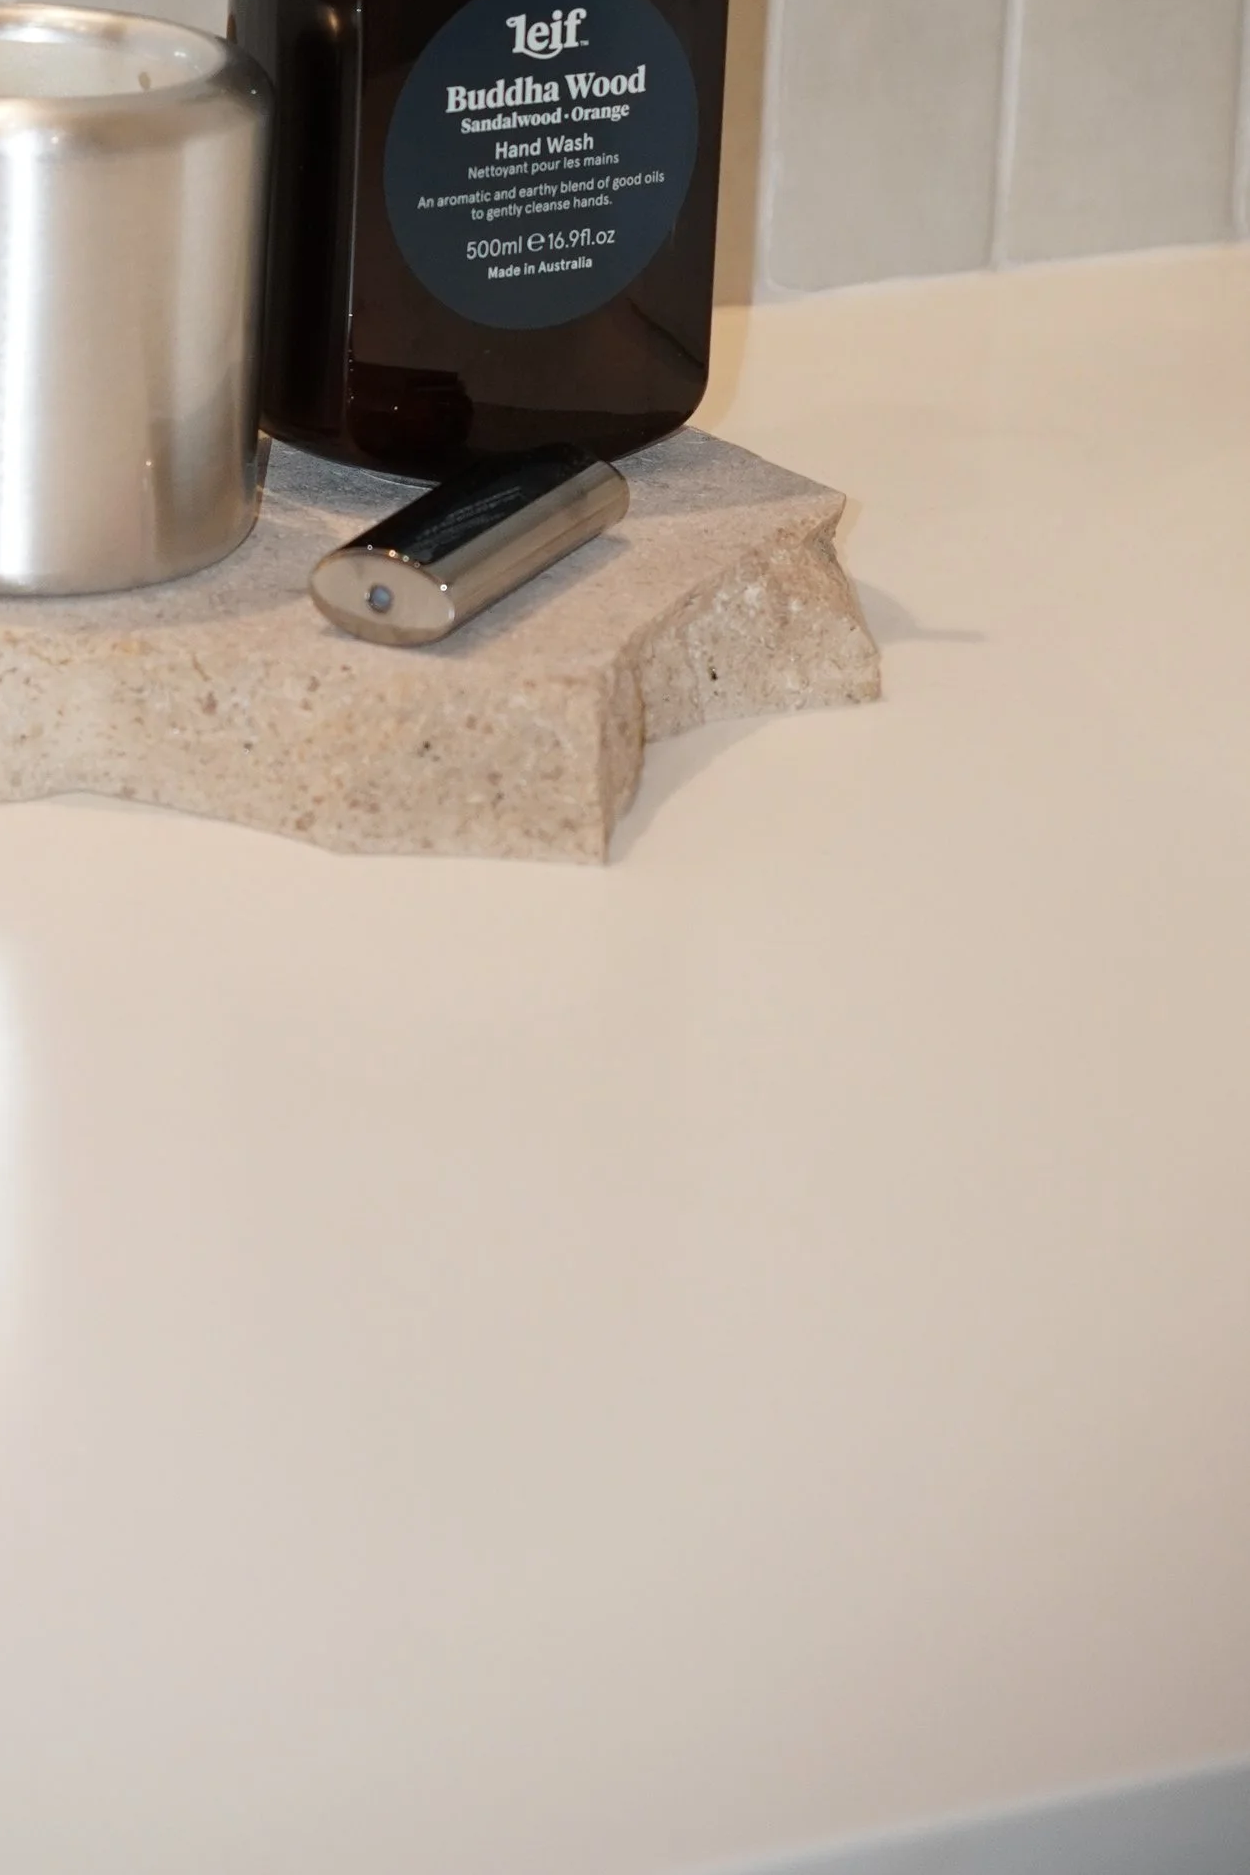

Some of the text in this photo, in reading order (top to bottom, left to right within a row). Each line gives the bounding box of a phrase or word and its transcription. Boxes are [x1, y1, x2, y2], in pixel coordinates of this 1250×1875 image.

[445, 64, 647, 114] Buddha Wood
[460, 107, 562, 135] Sandalwood
[571, 103, 630, 124] Orange
[495, 133, 594, 160] Hand Wash
[467, 152, 620, 180] Nettoyant pour les mains
[417, 170, 665, 210] An aromatic and earthy blend of good oils
[471, 193, 613, 222] to gently cleanse hands.
[466, 235, 523, 260] 500ml
[548, 228, 616, 250] 16.9fl.oz
[487, 256, 593, 280] Made in Australia
